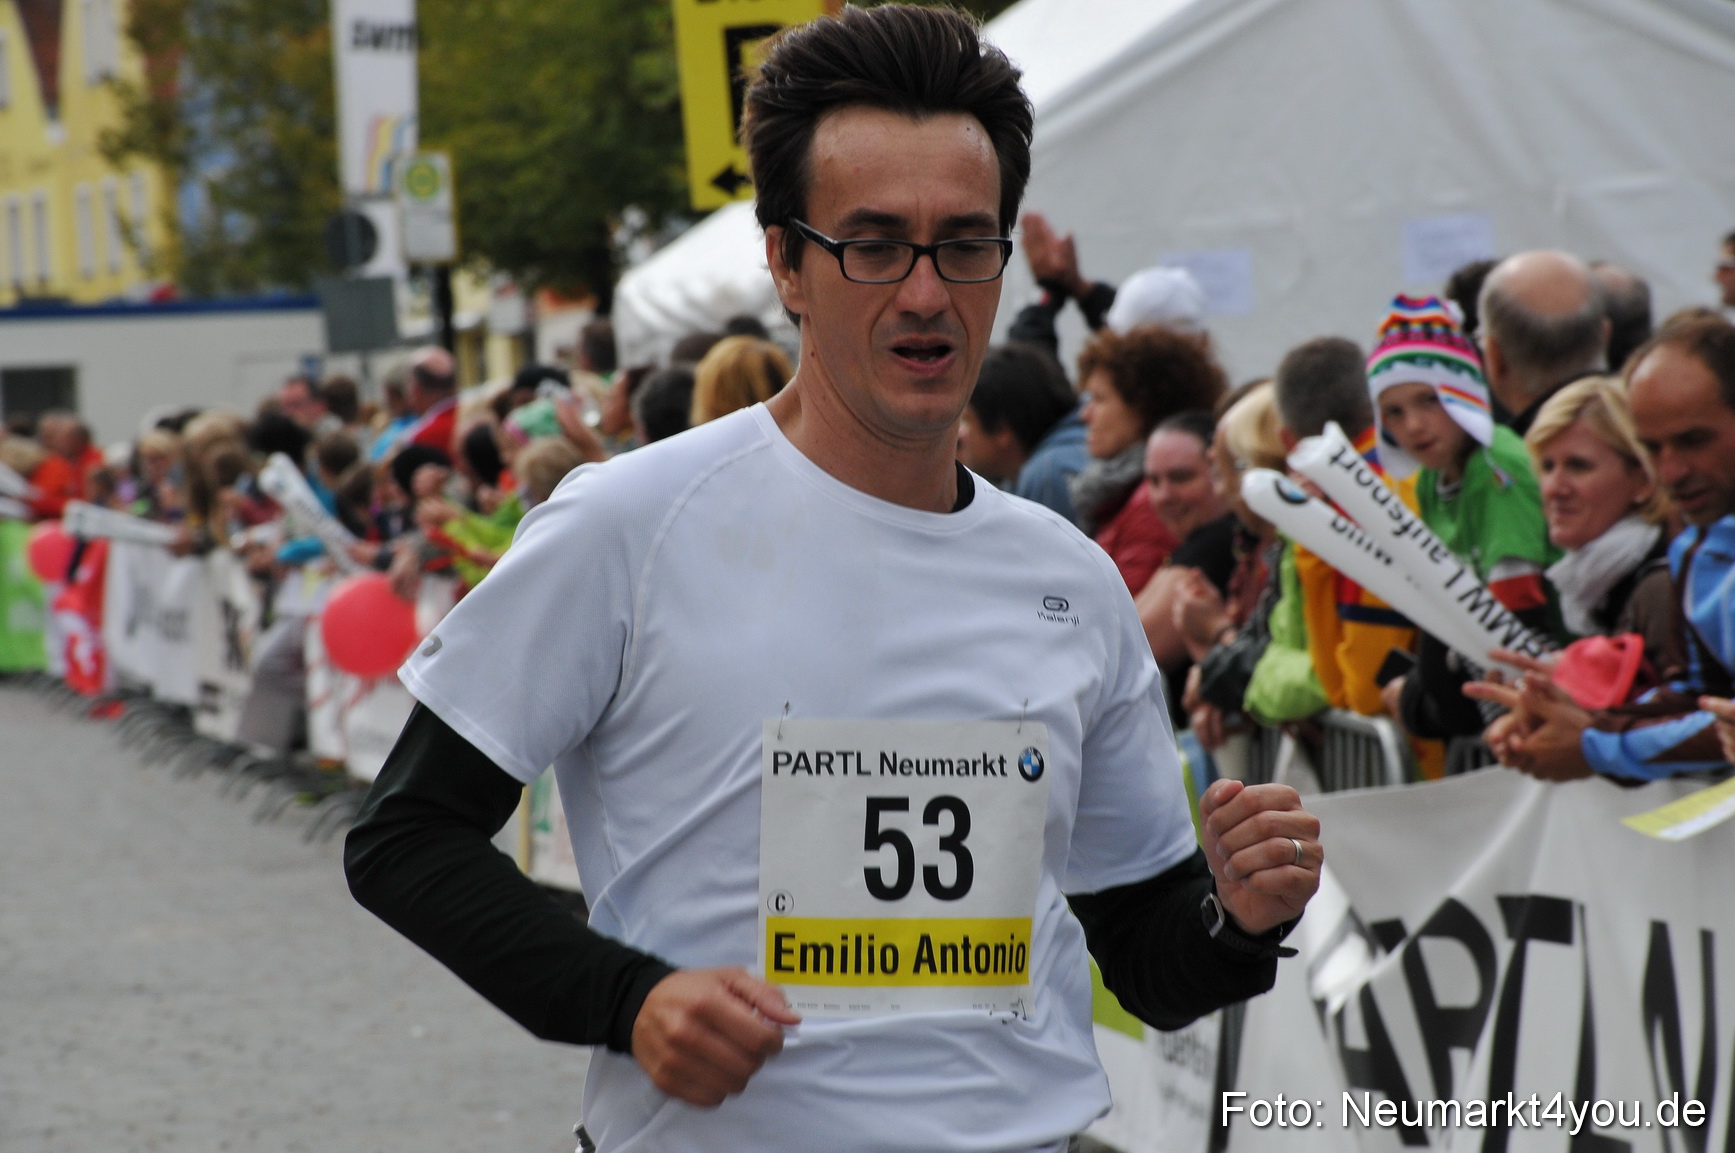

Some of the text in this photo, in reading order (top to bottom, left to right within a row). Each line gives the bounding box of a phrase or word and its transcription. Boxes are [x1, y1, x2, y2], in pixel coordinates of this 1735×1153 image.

[772, 751, 1008, 777] PARTL Neumarkt
[863, 794, 975, 903] 53
[773, 932, 1027, 975] Emilio Antonio
[1308, 893, 1634, 1153] ARTL
